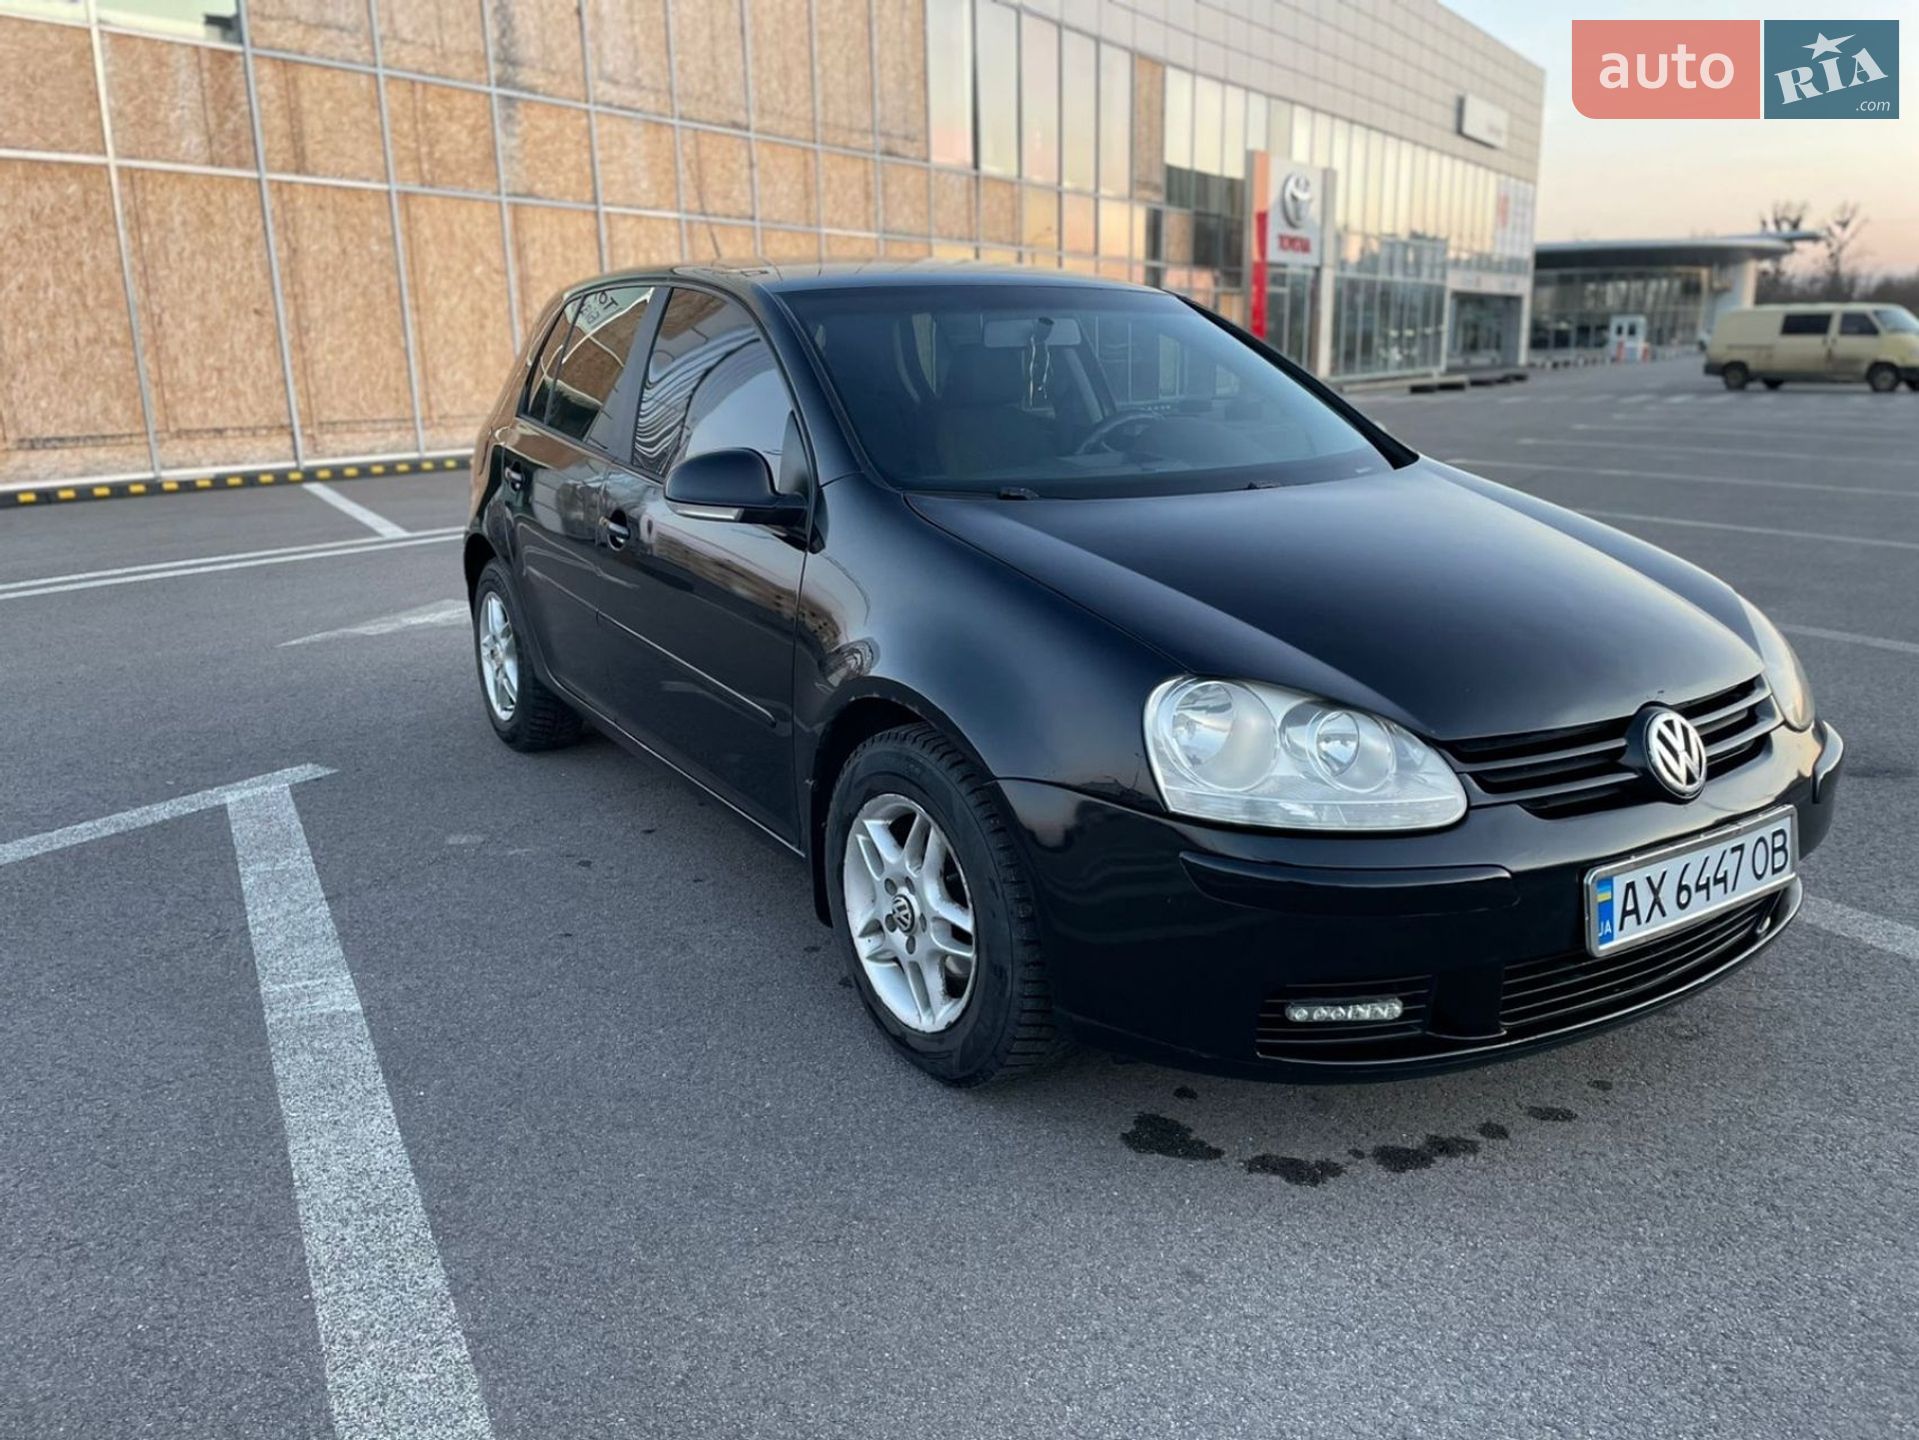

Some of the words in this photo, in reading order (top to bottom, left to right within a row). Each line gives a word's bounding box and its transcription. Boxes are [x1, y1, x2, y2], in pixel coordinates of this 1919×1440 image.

[1618, 869, 1667, 932] AX
[1675, 842, 1745, 911] 6447
[1751, 828, 1789, 881] OB
